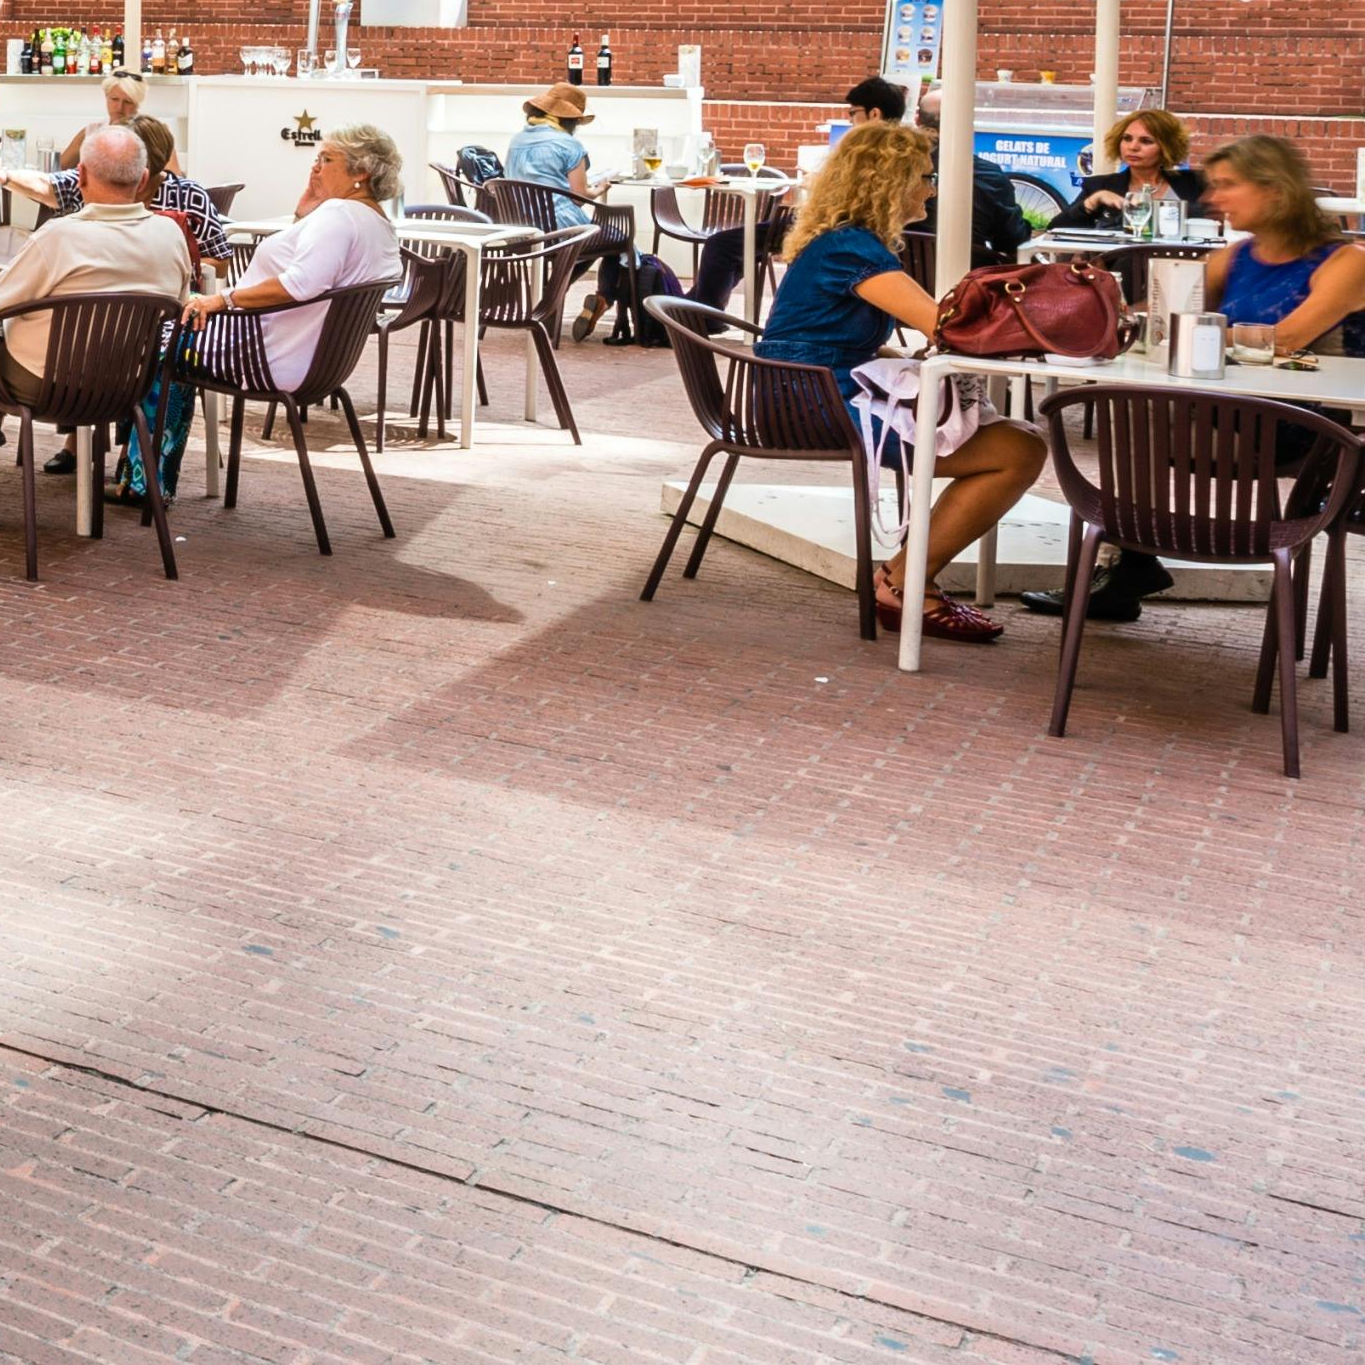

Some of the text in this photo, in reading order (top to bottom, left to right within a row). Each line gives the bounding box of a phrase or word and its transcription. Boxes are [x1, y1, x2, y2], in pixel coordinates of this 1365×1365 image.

[995, 139, 1050, 154] GELATS DE
[1016, 154, 1067, 169] NATURAL
